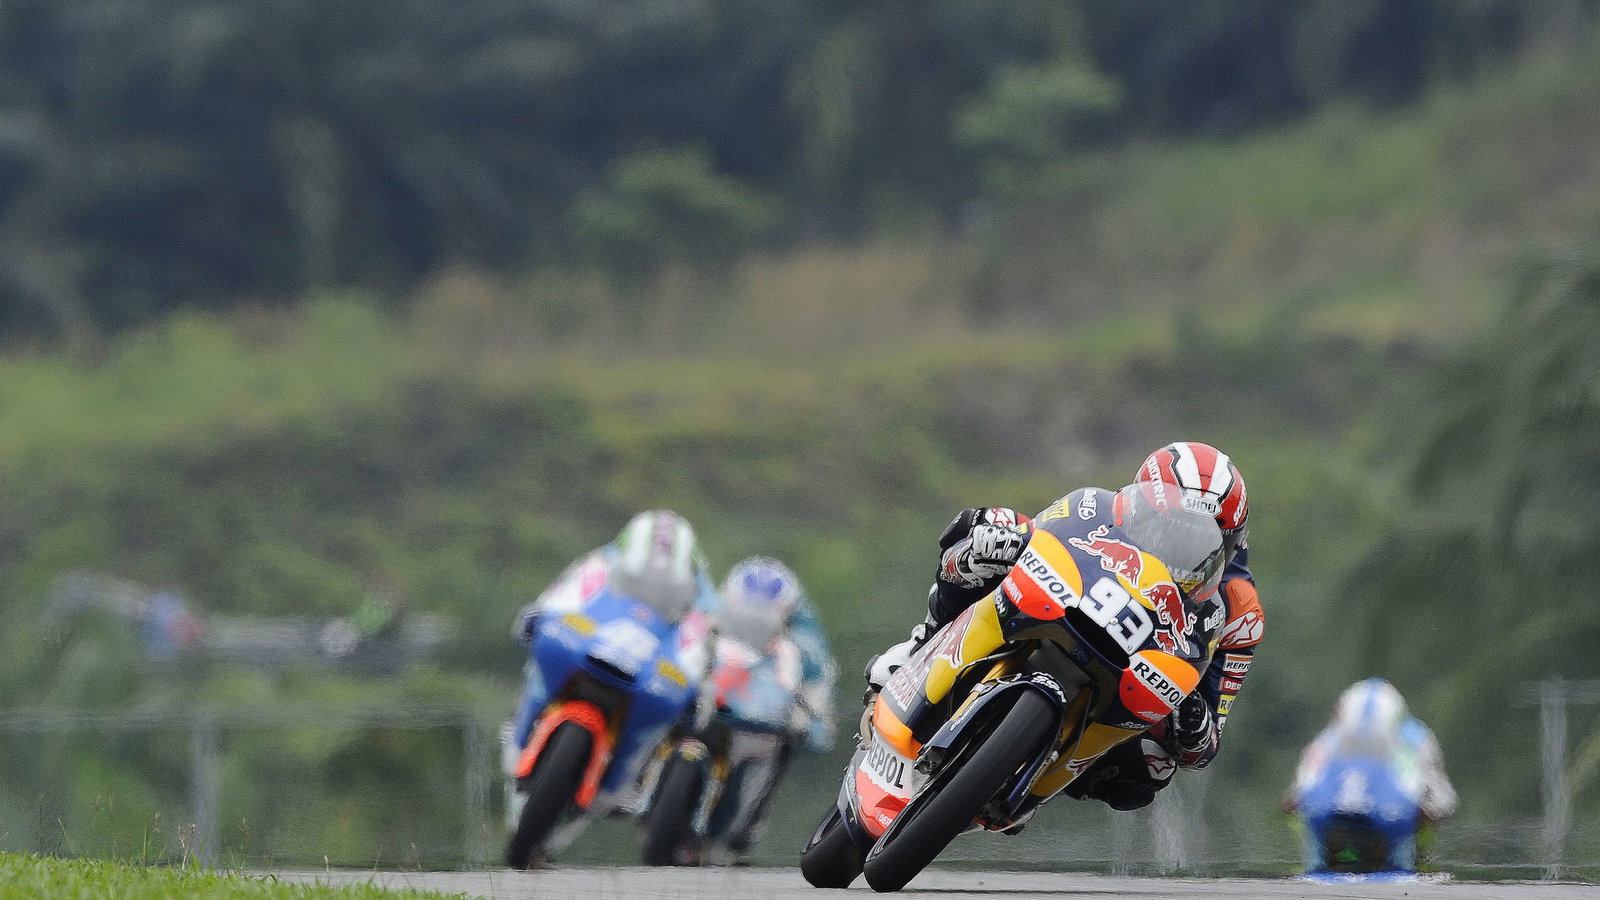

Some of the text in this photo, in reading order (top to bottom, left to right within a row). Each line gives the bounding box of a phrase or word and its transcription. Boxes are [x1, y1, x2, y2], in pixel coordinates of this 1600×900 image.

[1186, 498, 1217, 513] SHOEI
[1020, 551, 1073, 605] REPSOL
[1079, 576, 1154, 656] 93
[1133, 662, 1184, 708] REPSOL
[867, 738, 905, 789] REPSOL
